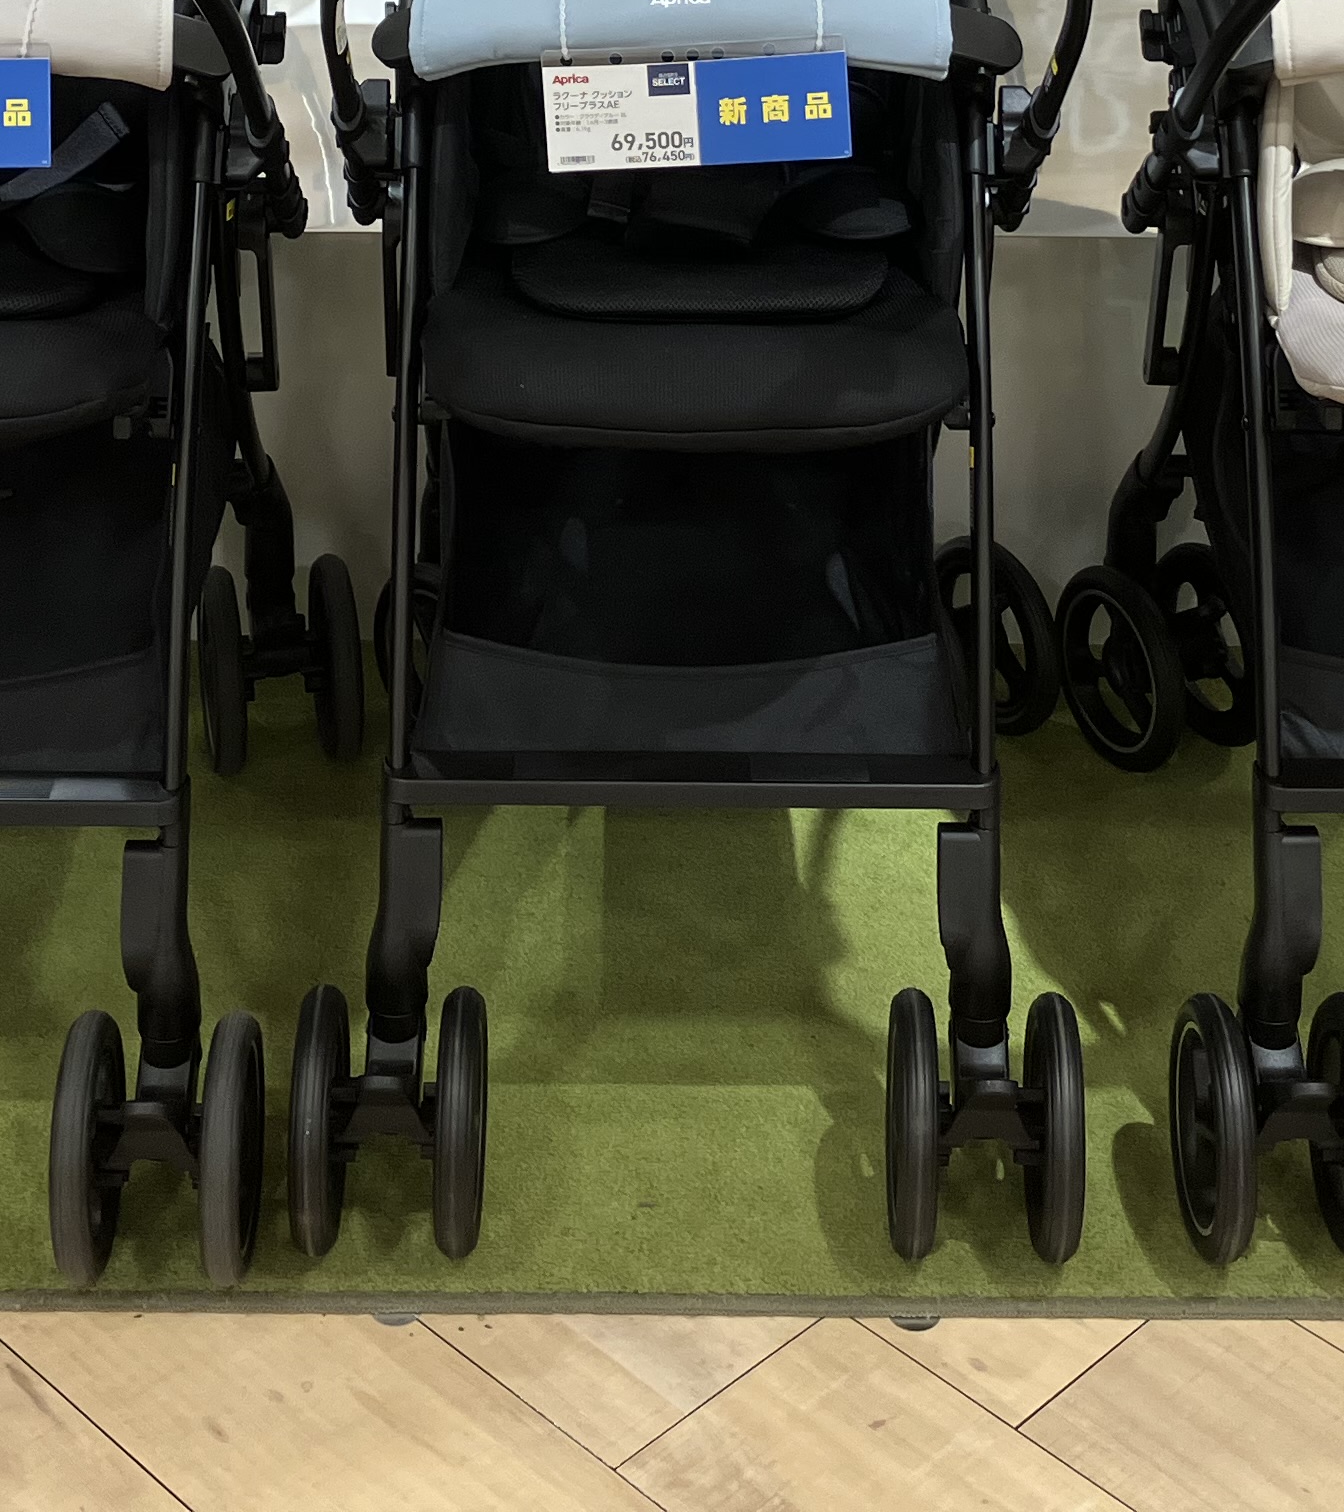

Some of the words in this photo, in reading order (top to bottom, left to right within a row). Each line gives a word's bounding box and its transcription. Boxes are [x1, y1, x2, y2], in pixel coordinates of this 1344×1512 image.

[552, 73, 589, 86] Aprica
[652, 77, 685, 87] SELECT
[552, 91, 587, 101] ラクーナ
[590, 90, 633, 99] クッション
[719, 91, 833, 126] 新商品
[611, 131, 694, 151] 69,500円
